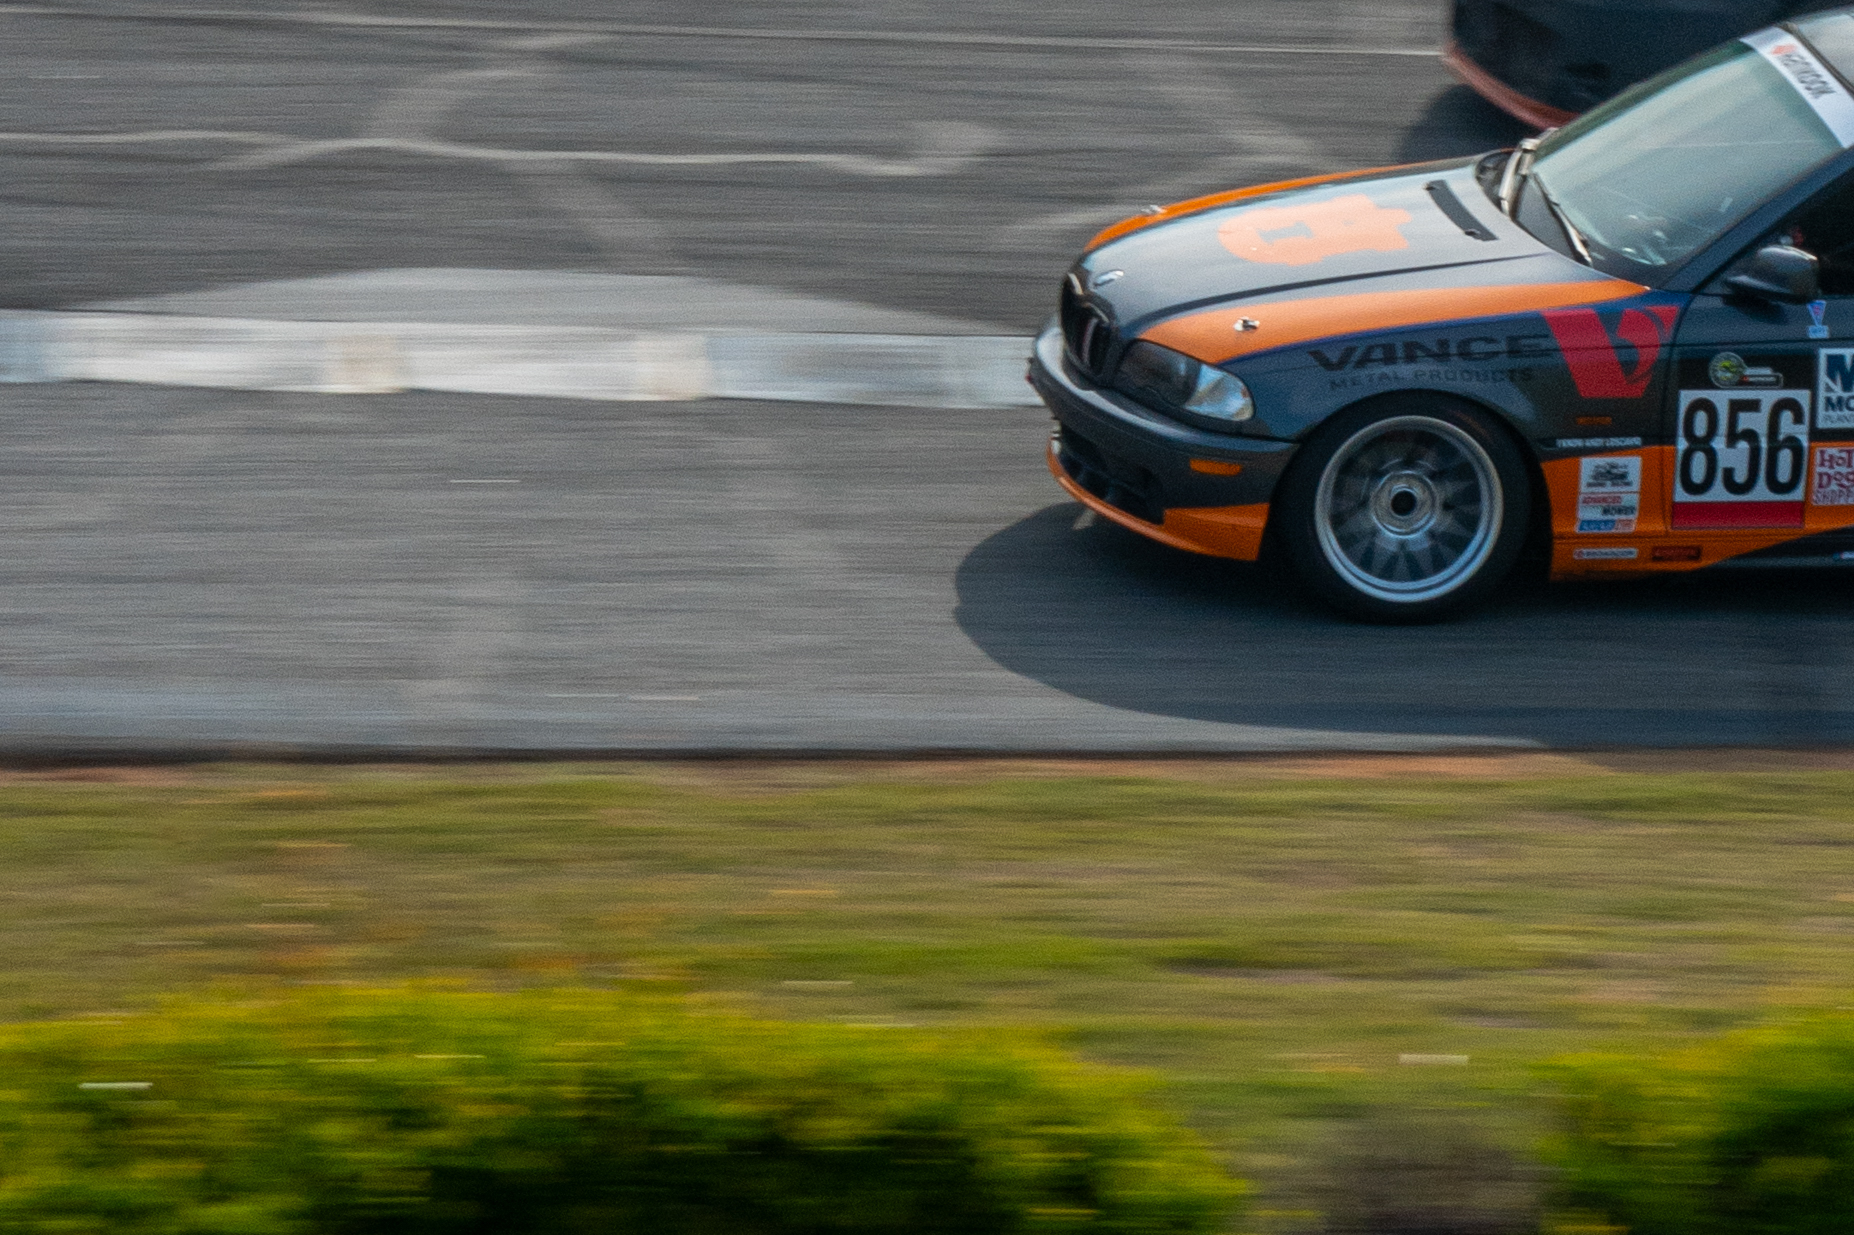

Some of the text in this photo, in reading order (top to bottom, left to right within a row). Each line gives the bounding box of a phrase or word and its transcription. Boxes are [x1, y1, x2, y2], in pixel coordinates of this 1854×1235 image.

[1307, 333, 1555, 371] VANCE
[1329, 367, 1534, 391] METAL PRODUCTS
[1680, 397, 1805, 496] 856
